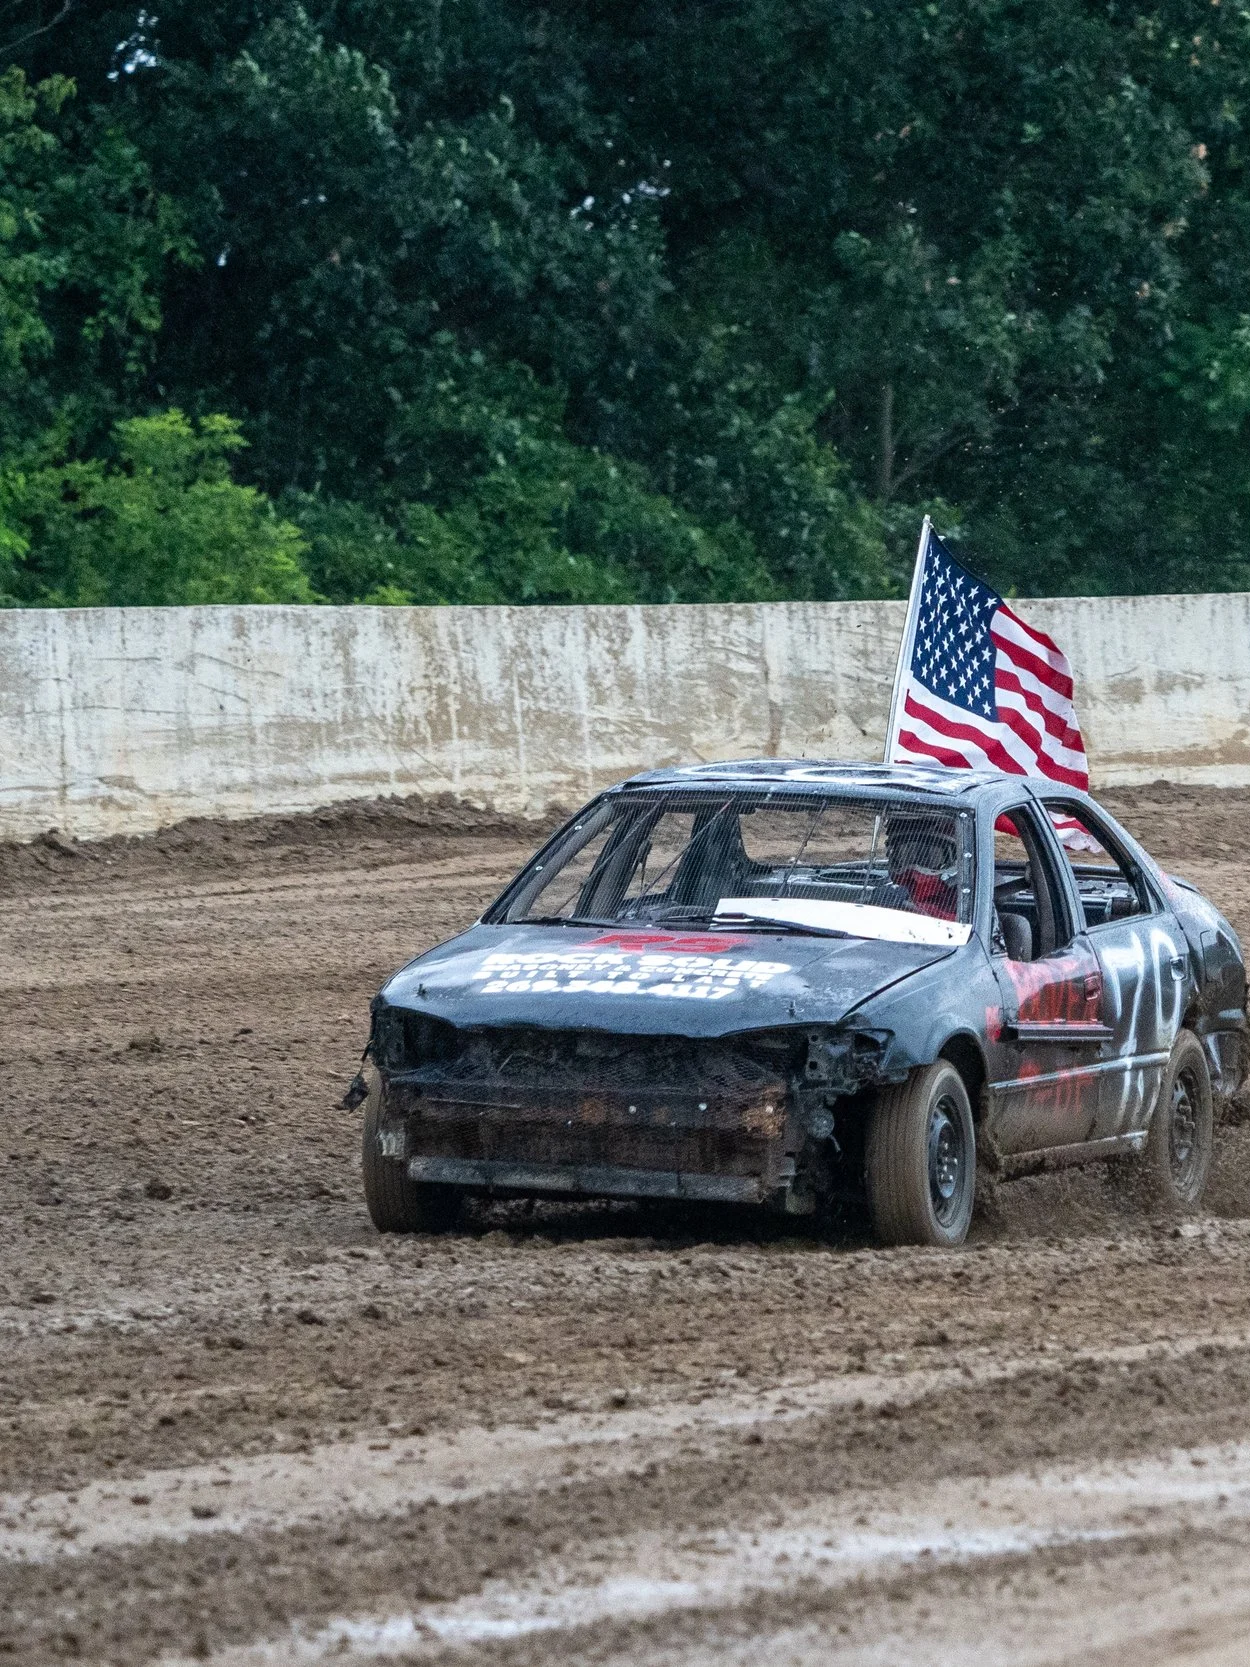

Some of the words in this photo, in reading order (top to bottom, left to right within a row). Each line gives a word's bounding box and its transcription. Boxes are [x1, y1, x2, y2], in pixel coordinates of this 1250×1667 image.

[479, 963, 610, 971] MASONRY
[639, 965, 774, 981] CONCRETE
[482, 952, 632, 965] ROCK
[636, 955, 792, 974] SOLID
[472, 970, 584, 980] BUILT
[607, 971, 650, 980] TO
[671, 974, 768, 988] LAST
